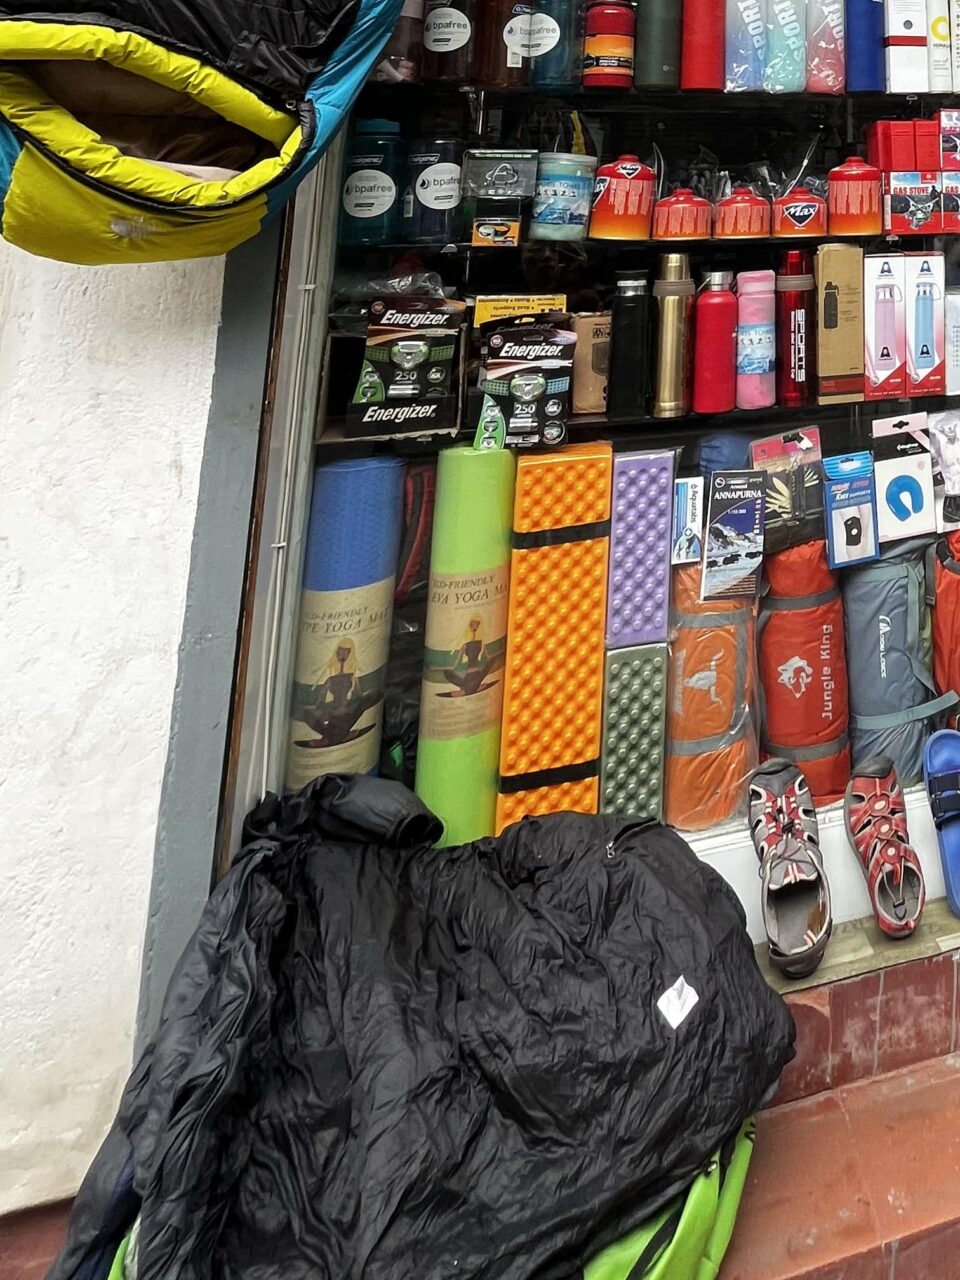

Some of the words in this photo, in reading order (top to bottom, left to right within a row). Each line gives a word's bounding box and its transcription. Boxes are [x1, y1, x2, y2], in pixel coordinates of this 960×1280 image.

[433, 20, 468, 30] bpafree
[354, 184, 392, 194] bpafree
[893, 186, 908, 195] GAS
[909, 186, 929, 195] STOVE
[945, 185, 959, 194] GAS
[783, 204, 818, 217] Max
[380, 309, 449, 327] Energizer
[500, 342, 563, 359] Energizer
[797, 309, 806, 382] SPORTS
[395, 371, 417, 380] 250
[362, 404, 437, 422] Energizer
[515, 404, 536, 414] 250
[714, 490, 762, 500] ANNAPURNA
[455, 588, 489, 604] YOGA
[325, 618, 362, 633] YOGA
[820, 625, 834, 659] King
[820, 666, 835, 720] Jungle
